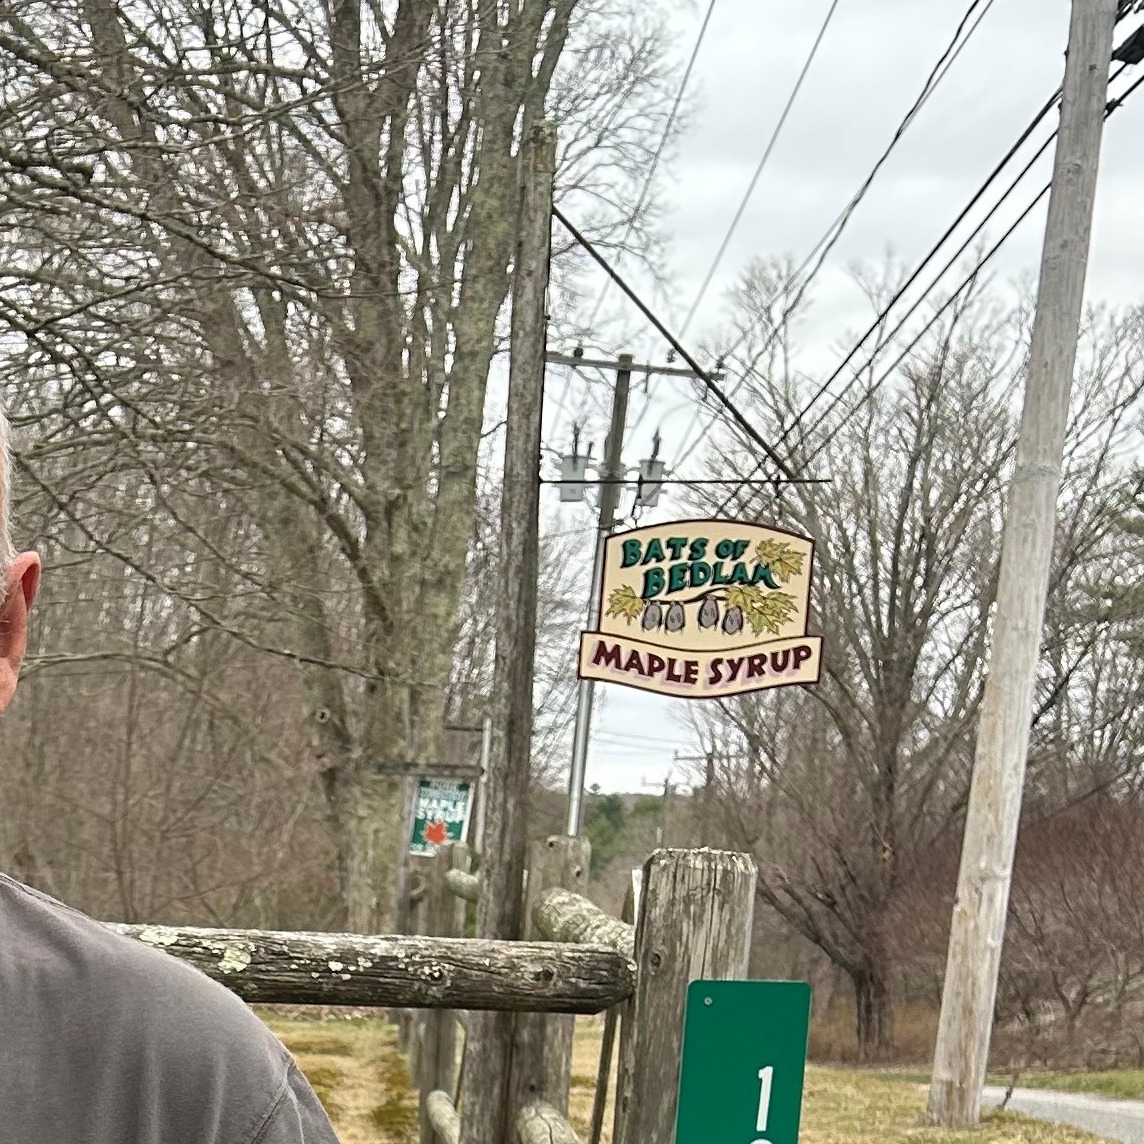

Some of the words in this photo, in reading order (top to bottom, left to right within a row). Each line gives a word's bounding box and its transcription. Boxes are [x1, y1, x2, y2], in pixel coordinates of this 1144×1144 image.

[620, 537, 710, 569] BATS
[715, 538, 751, 561] OF
[641, 561, 781, 600] BEDLAM
[593, 640, 699, 685] MAPLE
[708, 645, 812, 686] SYRUP
